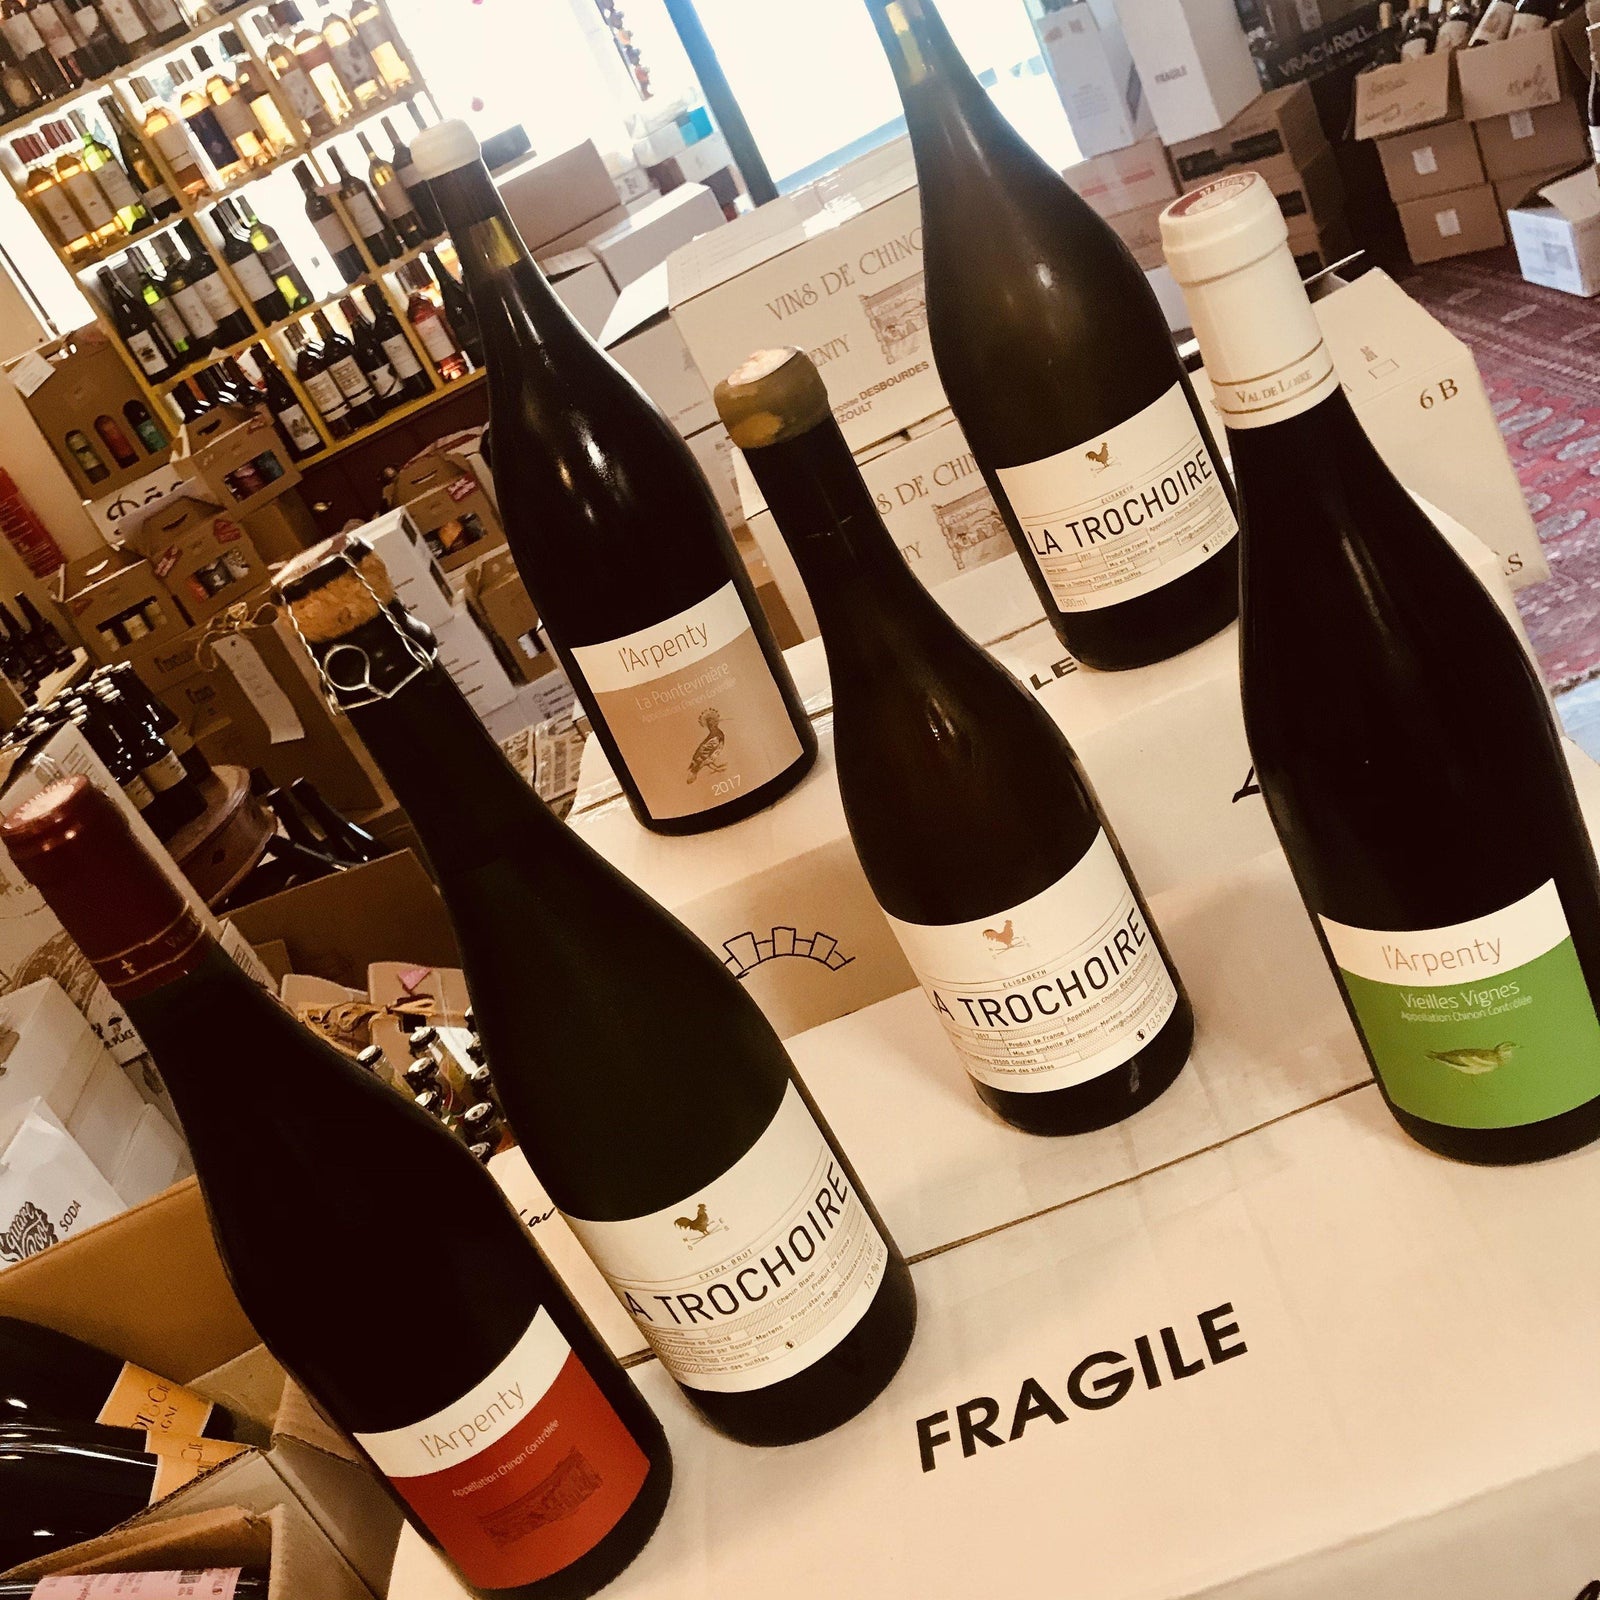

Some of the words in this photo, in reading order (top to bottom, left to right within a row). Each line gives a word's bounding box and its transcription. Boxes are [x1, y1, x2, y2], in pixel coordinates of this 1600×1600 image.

[765, 282, 819, 321] VINS
[820, 263, 855, 296] DE
[858, 227, 925, 276] CHINO
[858, 360, 930, 401] DESBOURDES
[1419, 388, 1434, 410] 6
[1437, 377, 1459, 401] B
[893, 475, 929, 506] DE
[1028, 528, 1063, 555] LA
[1065, 448, 1213, 548] TROCHOIRE
[1504, 553, 1524, 576] S
[618, 622, 709, 673] l'Arpenty
[634, 695, 653, 711] La
[652, 661, 730, 706] Pointevinière
[711, 773, 742, 797] 2017
[957, 907, 1146, 1027] TROCHOIRE
[1381, 937, 1501, 977] l'Arpenty
[1066, 1002, 1101, 1023] Appellation
[1399, 991, 1459, 1010] Vieilles
[1459, 981, 1520, 1007] Vignes
[1008, 1039, 1032, 1049] Produit
[1042, 1030, 1065, 1042] France
[1012, 1048, 1024, 1056] Mis
[1064, 1037, 1076, 1047] par
[59, 1199, 82, 1233] SODA
[621, 1290, 654, 1322] A
[653, 1160, 848, 1325] TROCHOIRE
[698, 1248, 753, 1281] EXTRA-BRUT
[811, 1269, 831, 1292] Produit
[776, 1287, 798, 1306] Chenin
[798, 1270, 816, 1289] Blanc
[916, 1302, 1248, 1473] FRAGILE
[419, 1381, 524, 1459] l'Arpenty
[452, 1471, 500, 1498] Appellation
[498, 1452, 527, 1476] Chinon
